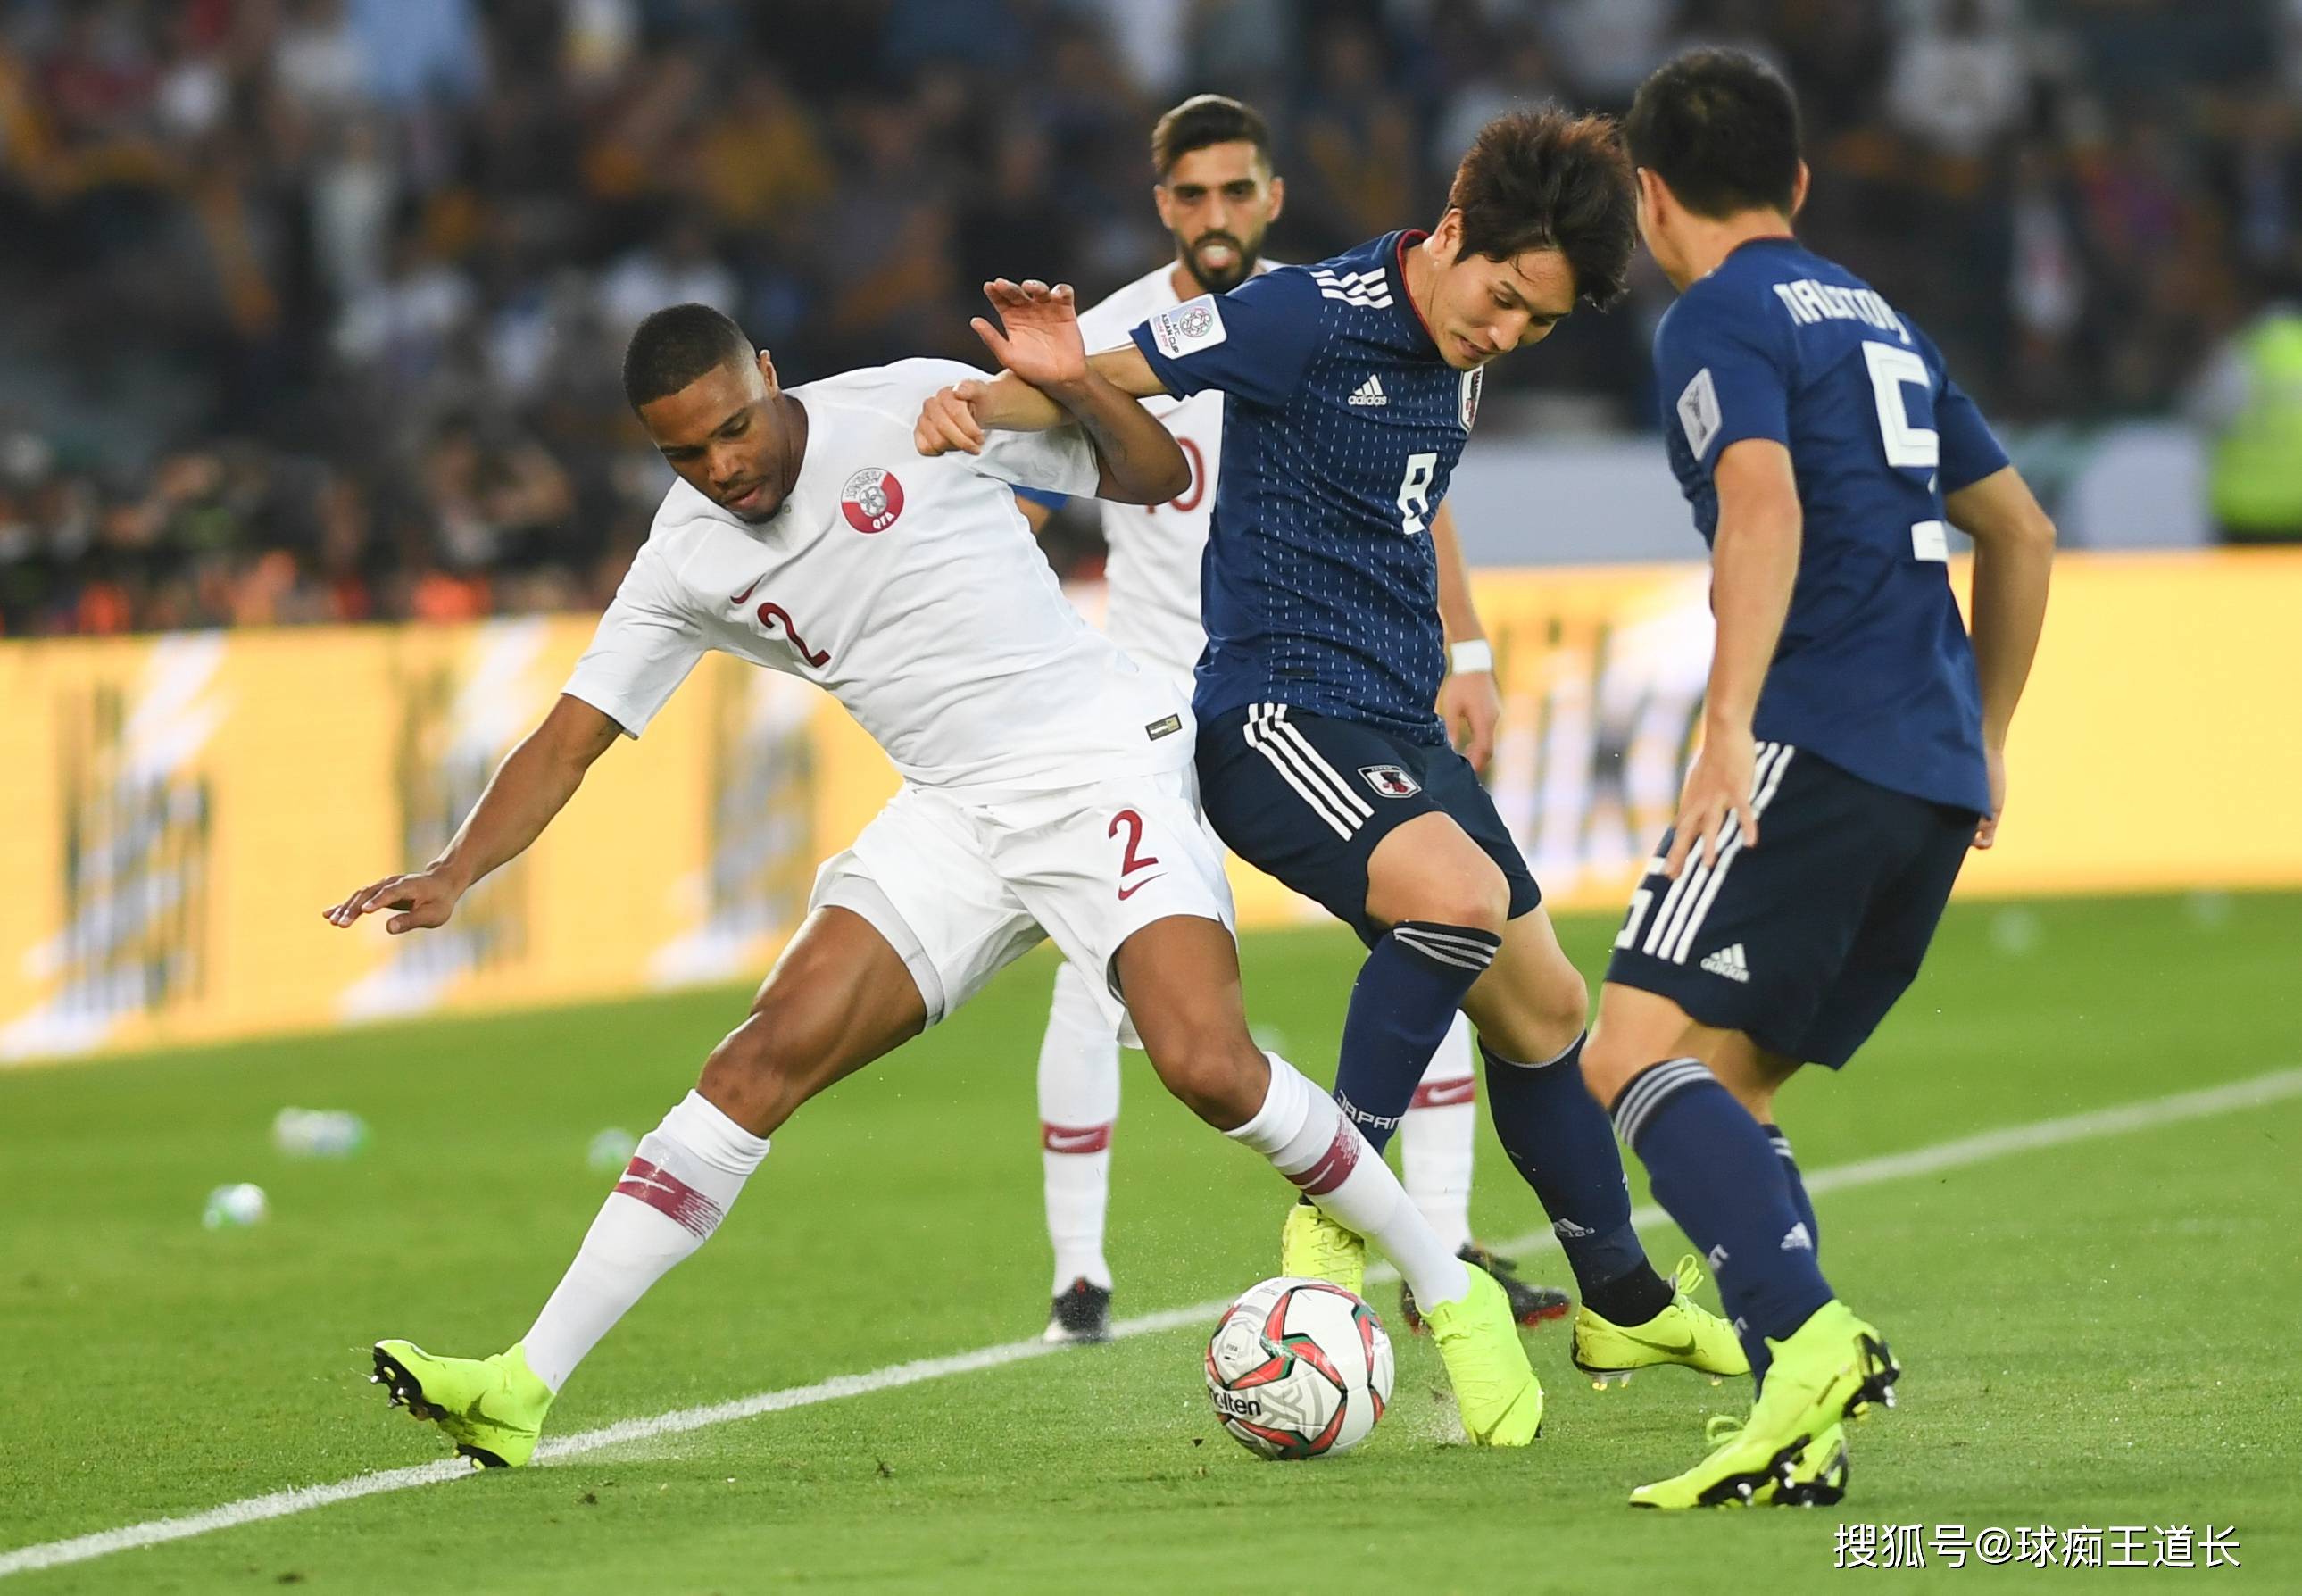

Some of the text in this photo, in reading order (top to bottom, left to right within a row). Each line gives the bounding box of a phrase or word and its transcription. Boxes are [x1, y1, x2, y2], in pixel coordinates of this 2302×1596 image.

[1161, 313, 1179, 353] ASIAN CUP
[1348, 395, 1387, 406] adidas
[1397, 452, 1437, 536] 8
[757, 602, 831, 669] 2
[1108, 809, 1159, 877] 2
